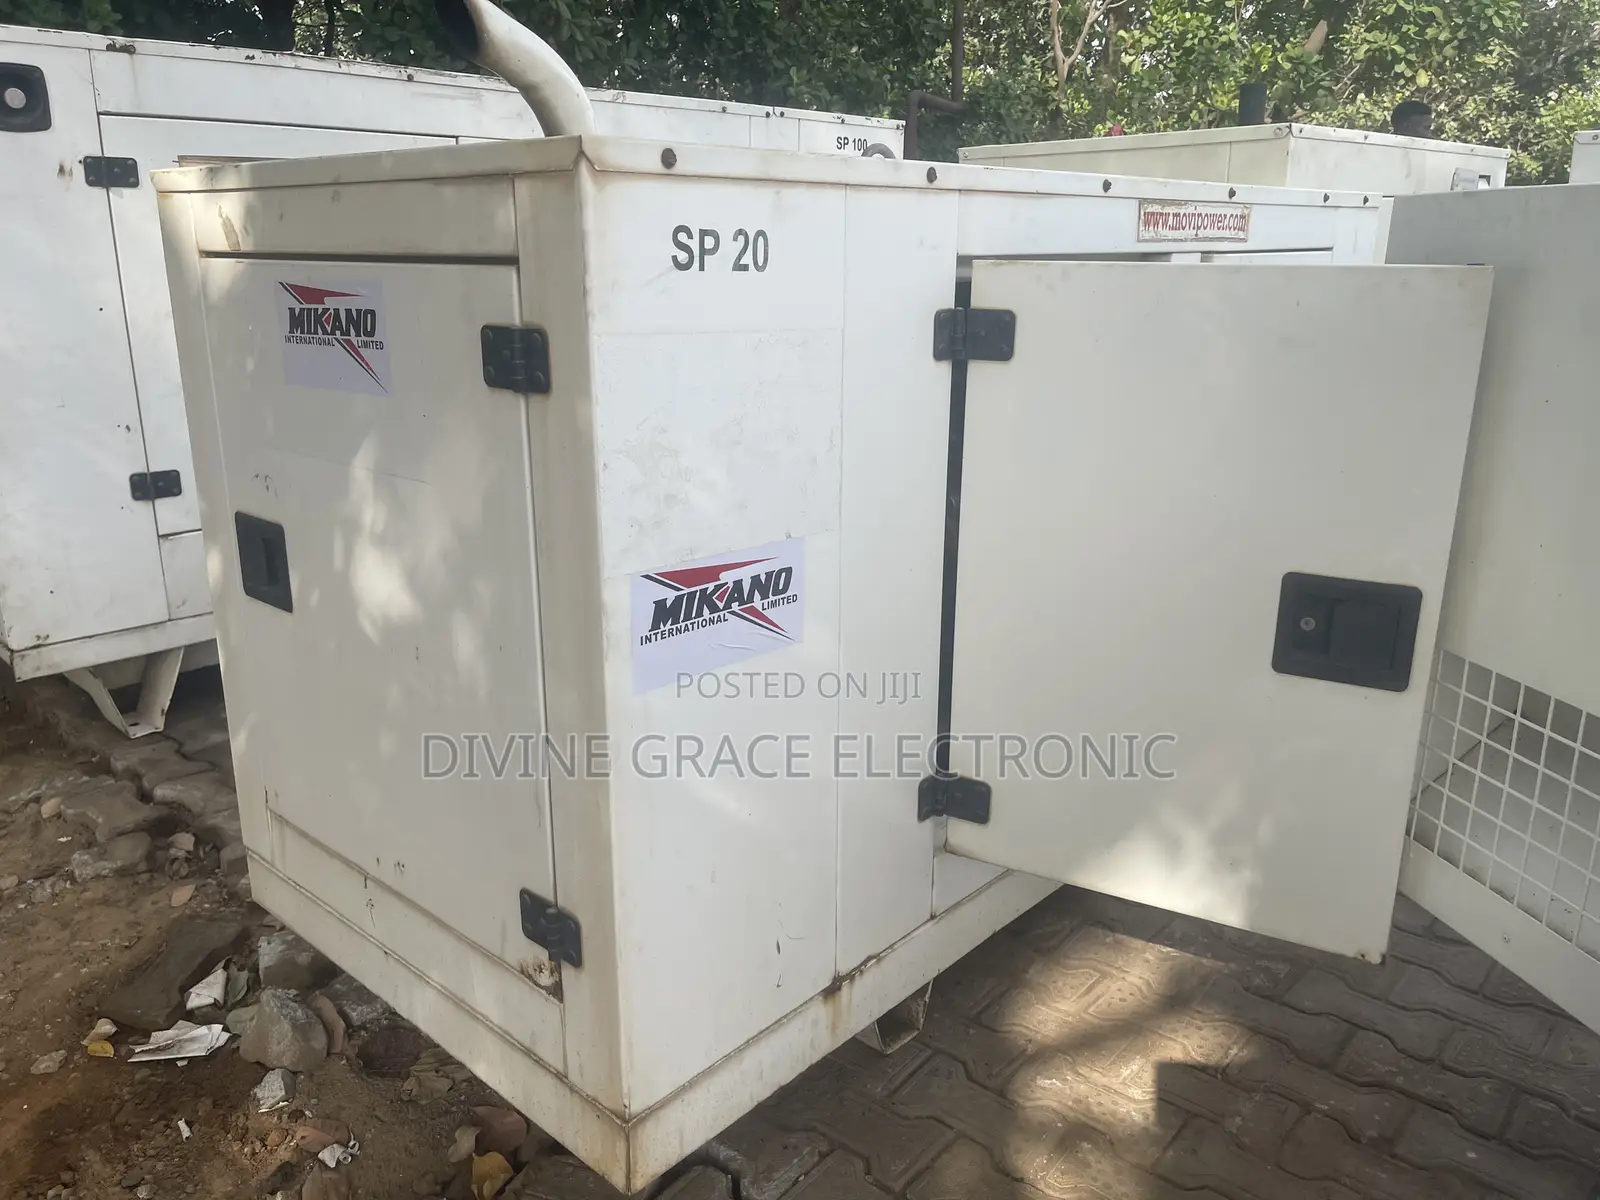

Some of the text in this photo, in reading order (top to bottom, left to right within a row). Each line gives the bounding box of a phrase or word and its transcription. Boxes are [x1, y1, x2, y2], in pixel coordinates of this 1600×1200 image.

[836, 136, 868, 152] SP 100
[1143, 210, 1247, 235] www.movipower.com
[671, 224, 769, 273] SP 20
[287, 306, 377, 338] MIKANO
[284, 334, 335, 347] INTERNATIONAL
[356, 339, 384, 350] LIMITED
[648, 566, 793, 633] MIKANO
[761, 593, 798, 611] LIMITED
[640, 612, 729, 646] INTERNATIONAL
